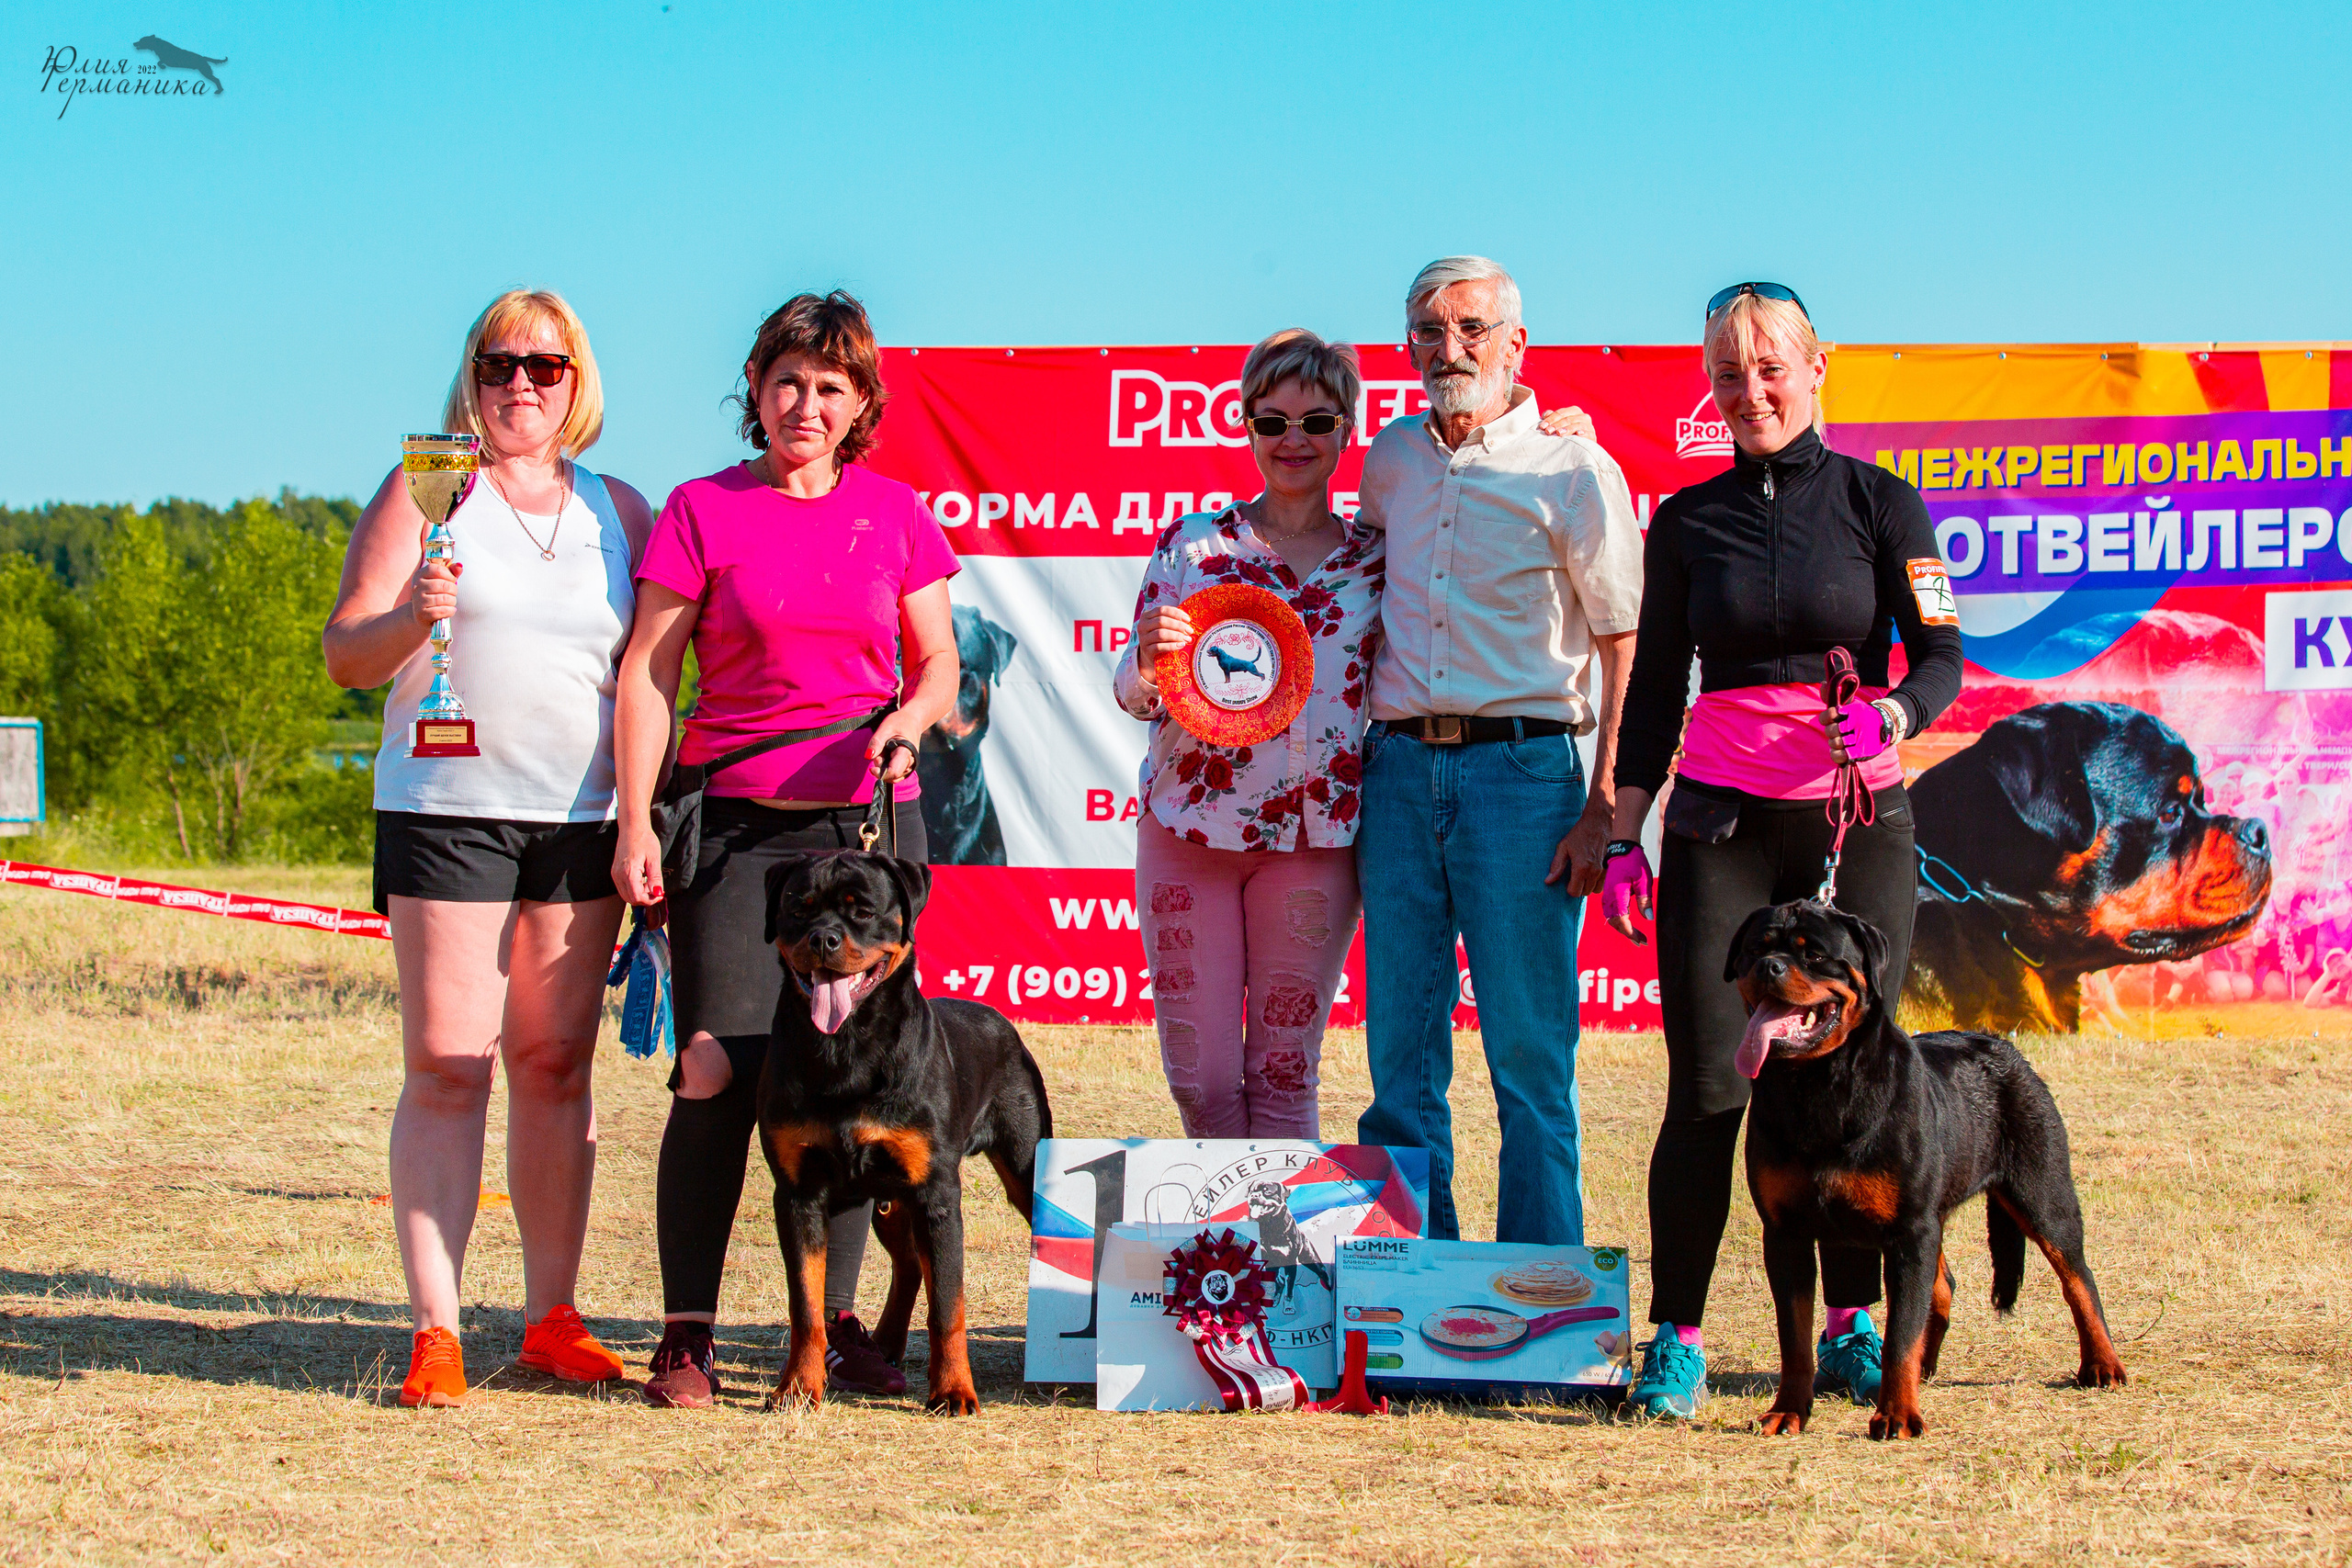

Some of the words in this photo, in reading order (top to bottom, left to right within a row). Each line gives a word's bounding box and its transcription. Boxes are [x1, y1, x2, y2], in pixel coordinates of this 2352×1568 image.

[919, 491, 1101, 529] ОРМА
[164, 890, 226, 911] ТРАПЕЗА
[274, 906, 336, 927] ТРАПЕЗА
[943, 965, 994, 996] +7
[1008, 964, 1127, 1007] (909)
[1193, 1156, 1268, 1219] ЕЙЛЕР
[1285, 1154, 1354, 1188] КЛУБ
[1131, 1292, 1161, 1304] AMI
